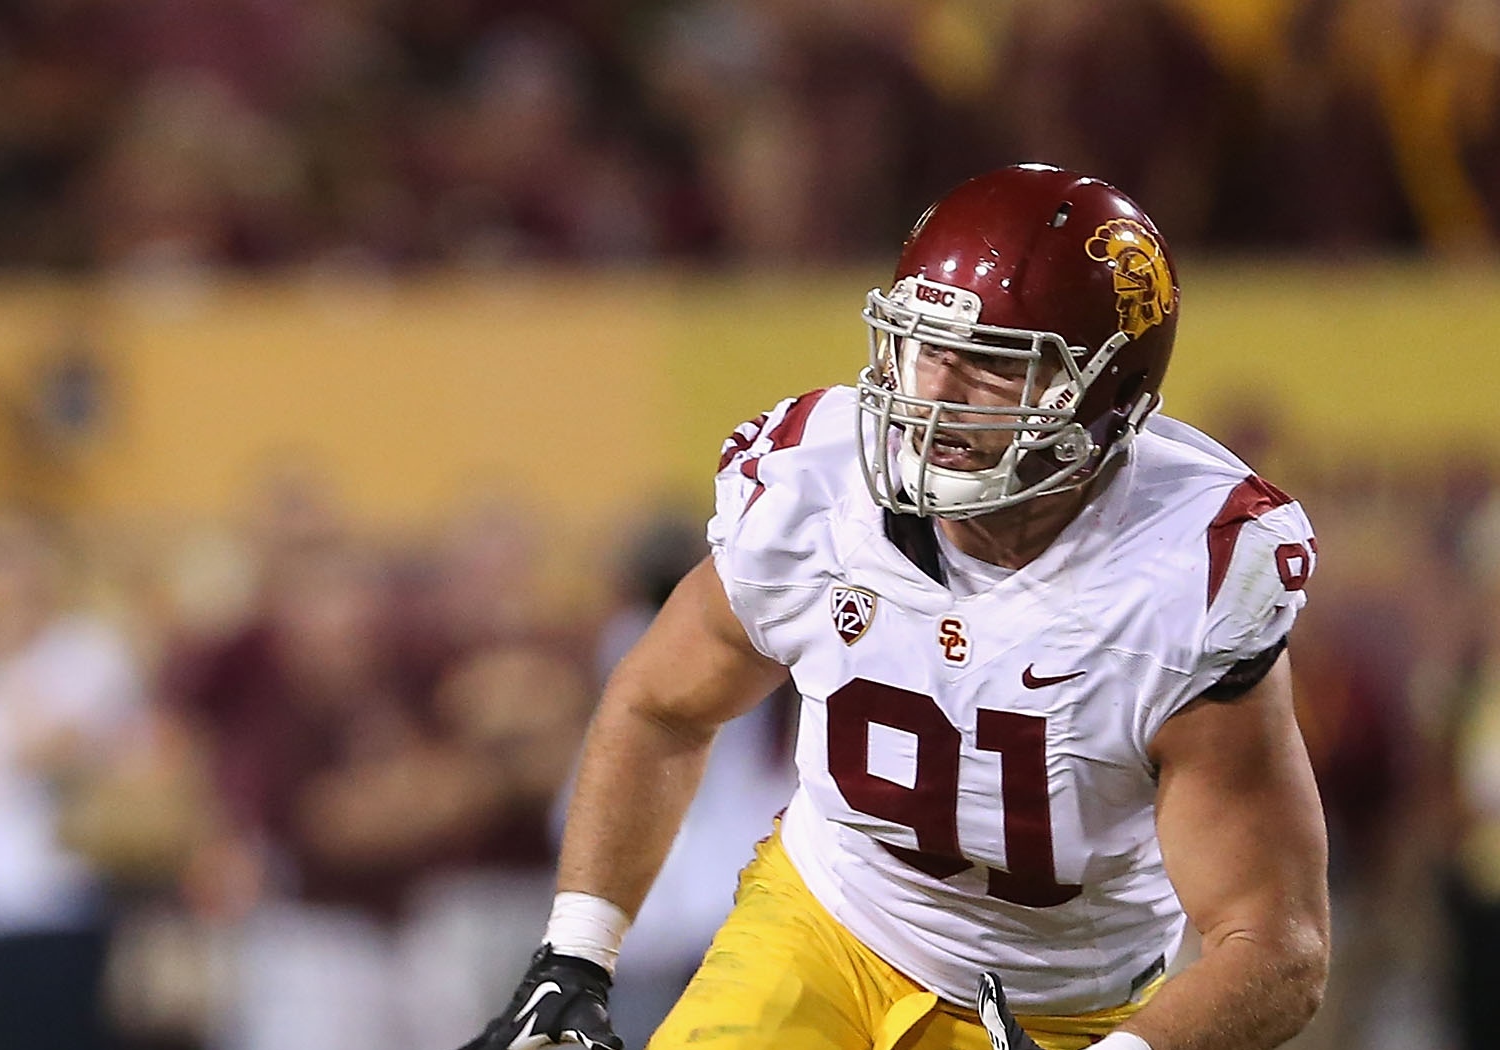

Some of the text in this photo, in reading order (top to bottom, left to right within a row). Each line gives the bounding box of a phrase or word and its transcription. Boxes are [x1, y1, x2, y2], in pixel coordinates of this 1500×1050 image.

[916, 283, 956, 307] USC
[832, 589, 873, 625] PAC
[837, 611, 860, 635] 12
[826, 676, 1083, 908] 91
